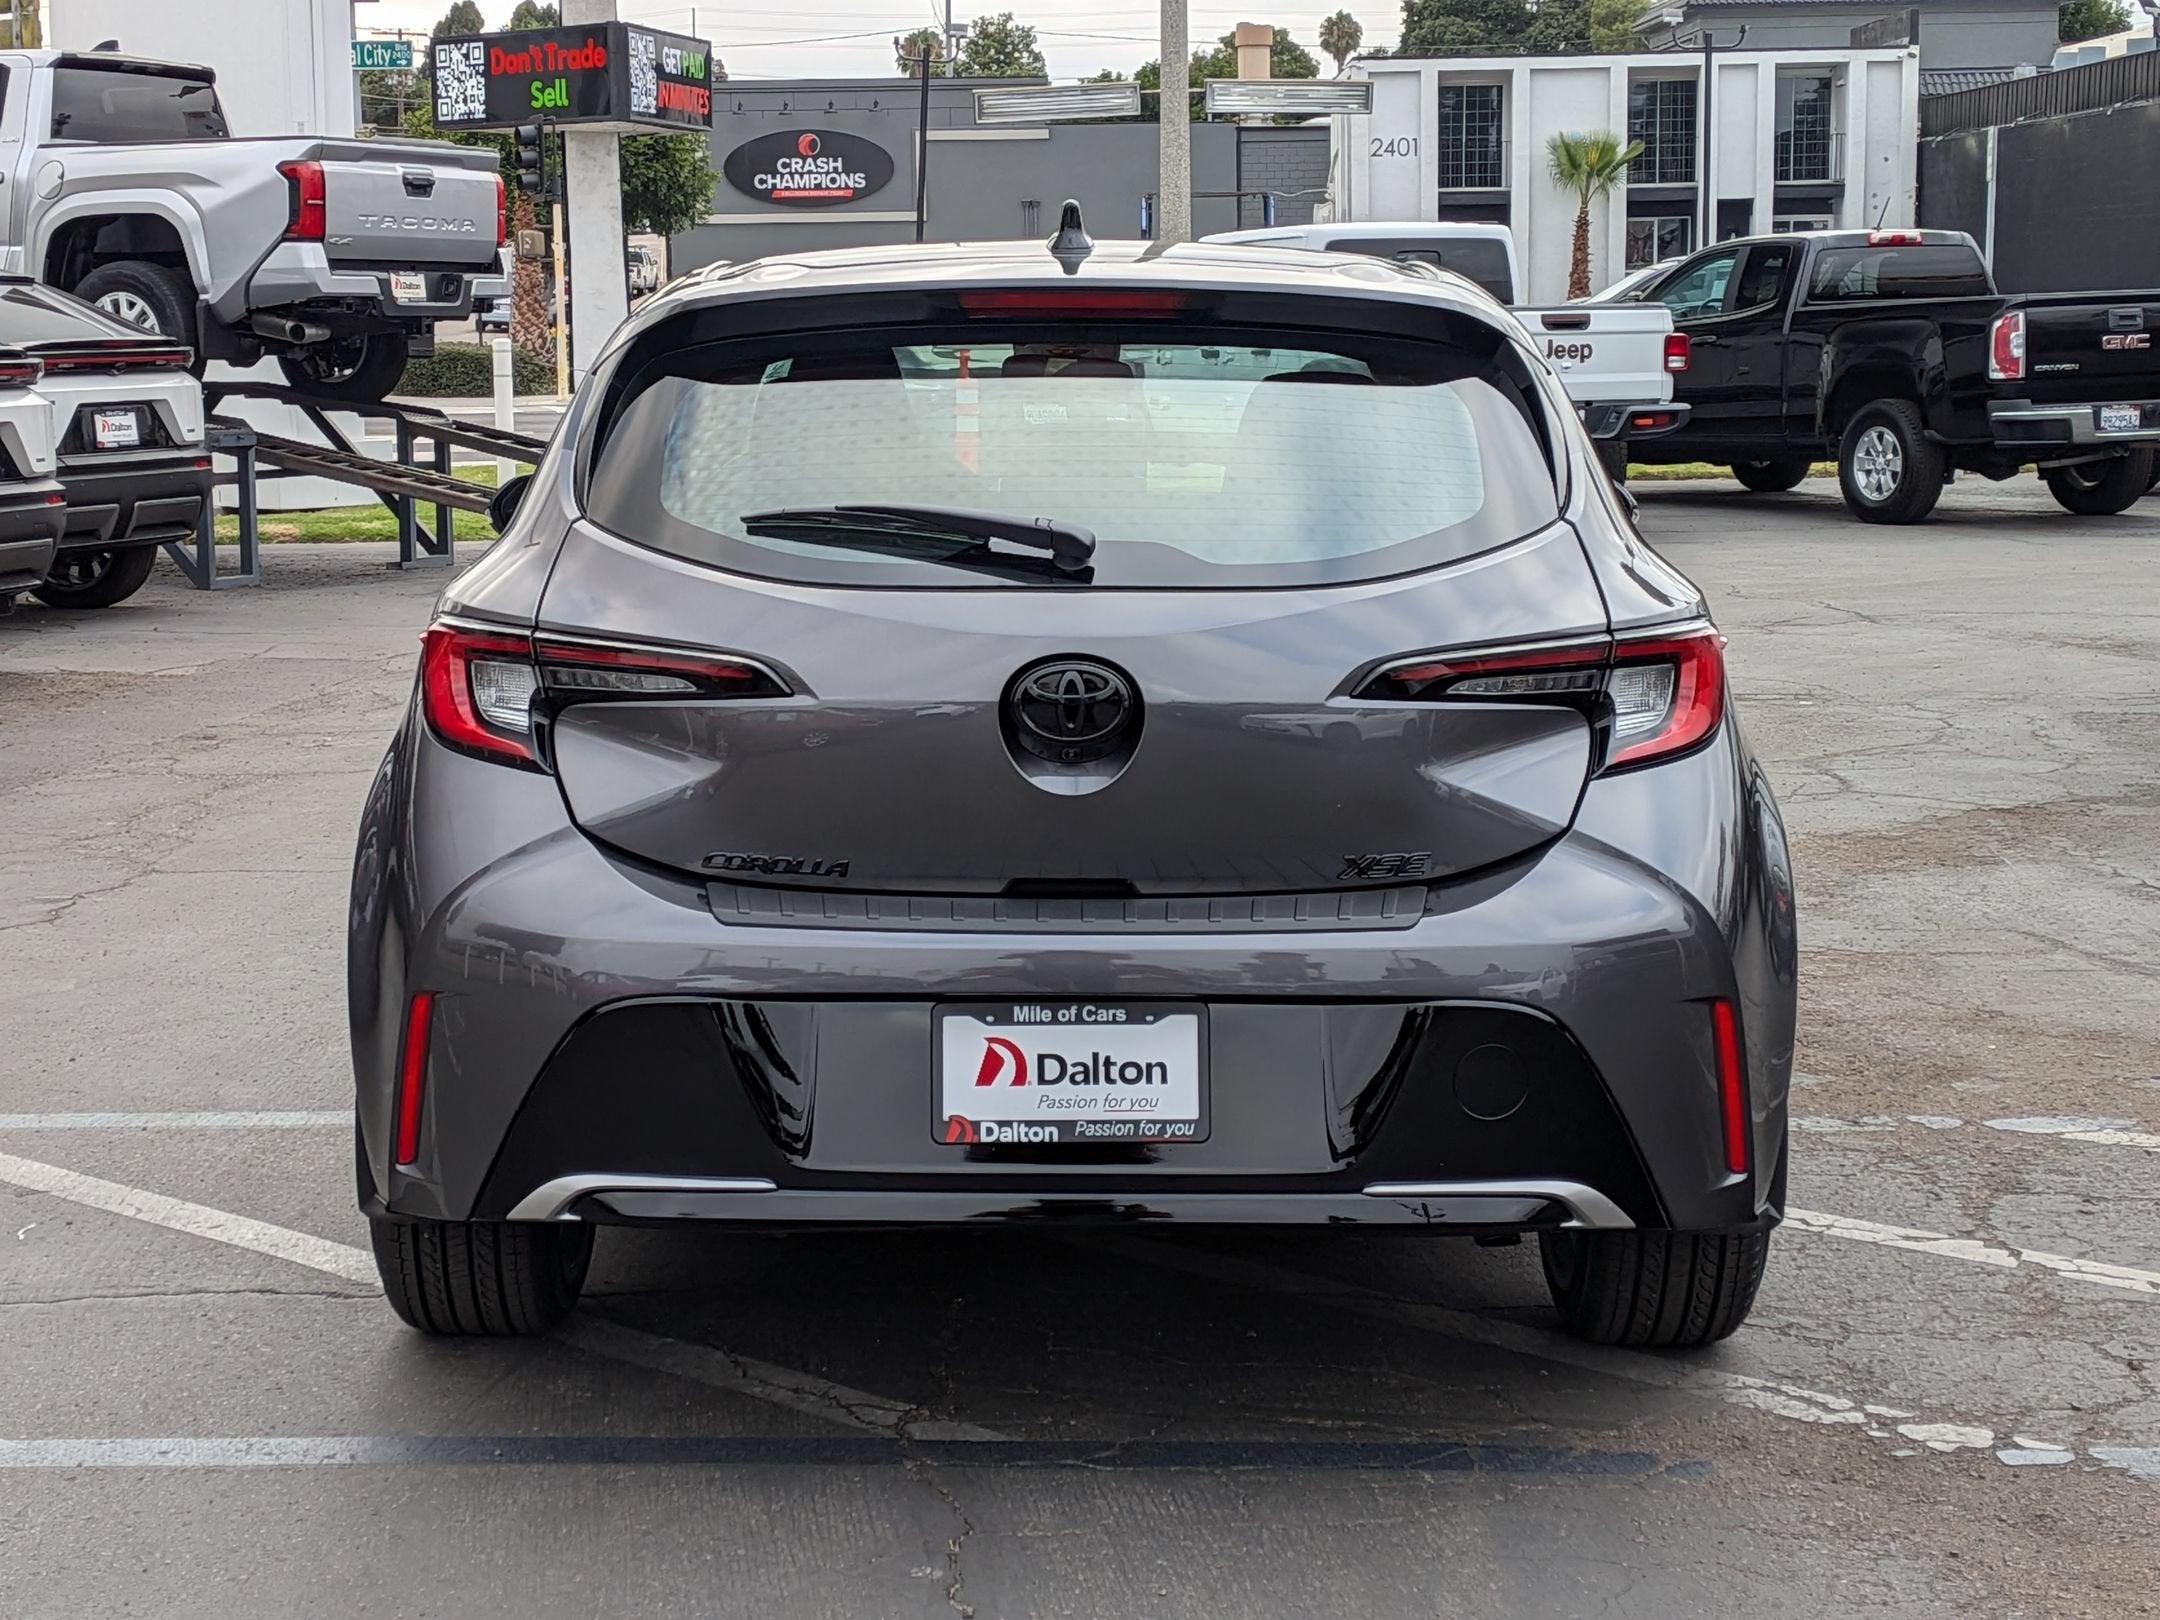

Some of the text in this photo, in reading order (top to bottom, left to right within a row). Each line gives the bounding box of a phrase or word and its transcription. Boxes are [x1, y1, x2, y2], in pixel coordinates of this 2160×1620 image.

[364, 43, 392, 66] City
[489, 37, 608, 76] Don't Trade
[662, 45, 705, 80] GET PAID
[530, 78, 569, 109] Sell
[670, 81, 710, 116] MINUTES
[1370, 137, 1418, 157] 2401
[776, 157, 843, 174] CRASH
[753, 173, 867, 189] CHAMPIONS
[357, 213, 477, 233] TACOMA
[1545, 338, 1593, 364] Jeep
[2102, 333, 2151, 350] GMC
[2034, 363, 2080, 372] CANYON
[700, 851, 850, 879] COROLLA
[1337, 851, 1433, 880] XSE
[1013, 1005, 1127, 1023] Mile of Cars
[1036, 1051, 1168, 1087] Dalton
[1037, 1092, 1159, 1111] Passion for you
[980, 1122, 1059, 1143] Dalton
[1074, 1120, 1195, 1138] Passion for you
